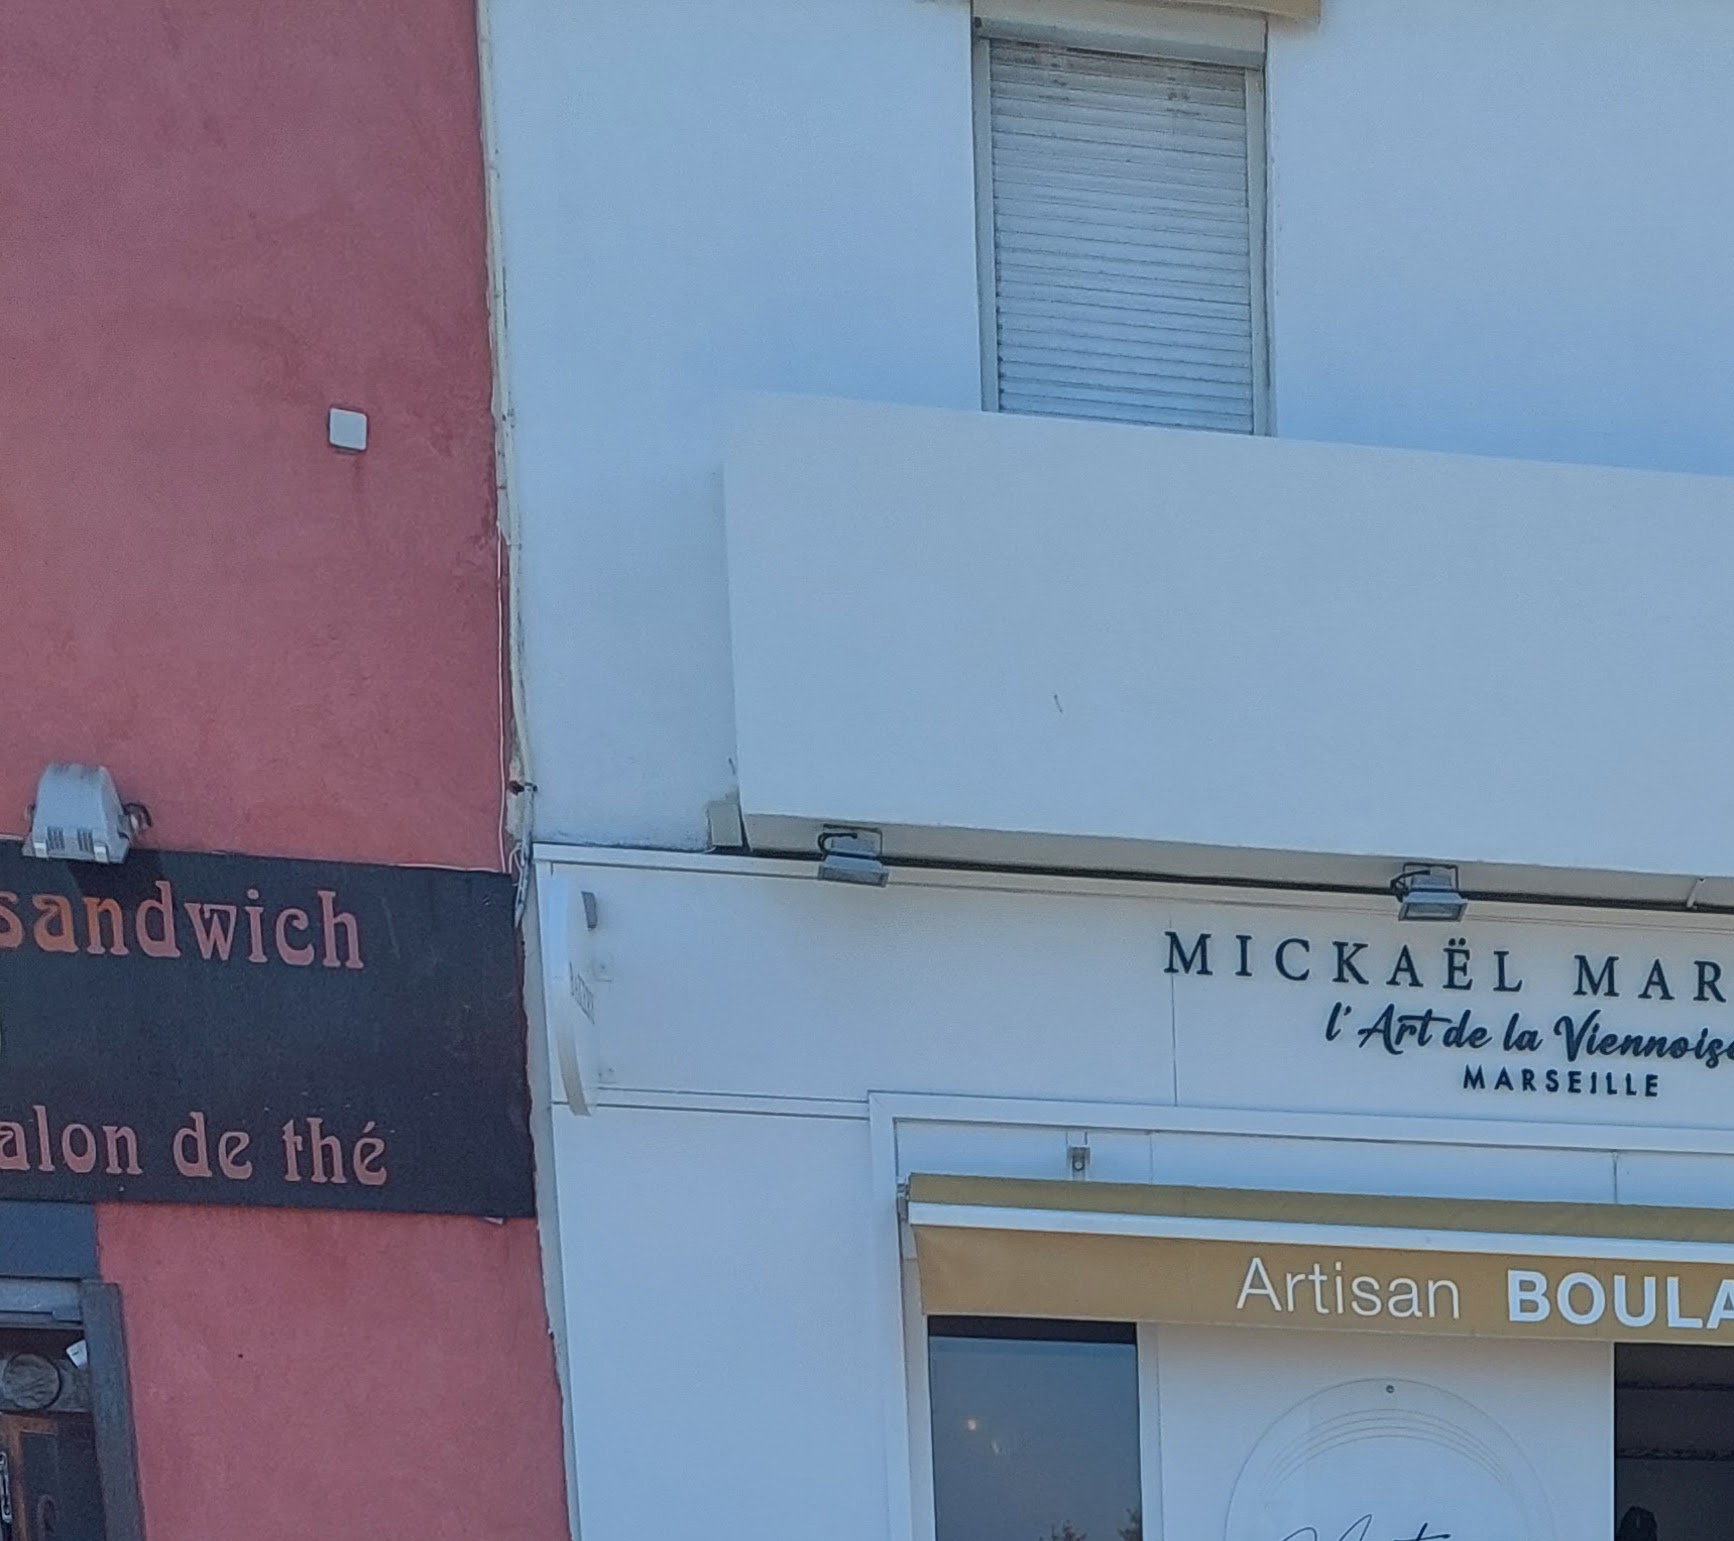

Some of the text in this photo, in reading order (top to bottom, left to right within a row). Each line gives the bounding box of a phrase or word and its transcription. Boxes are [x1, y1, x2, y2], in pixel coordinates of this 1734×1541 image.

[0, 880, 364, 969] sandwich
[1164, 931, 1523, 993] MICKAËL
[1444, 1009, 1492, 1049] de
[1503, 1012, 1543, 1052] la
[1463, 1064, 1659, 1097] MARSEILLE
[173, 1112, 252, 1179] de
[282, 1117, 387, 1185] thé
[1236, 1256, 1460, 1320] Artisan
